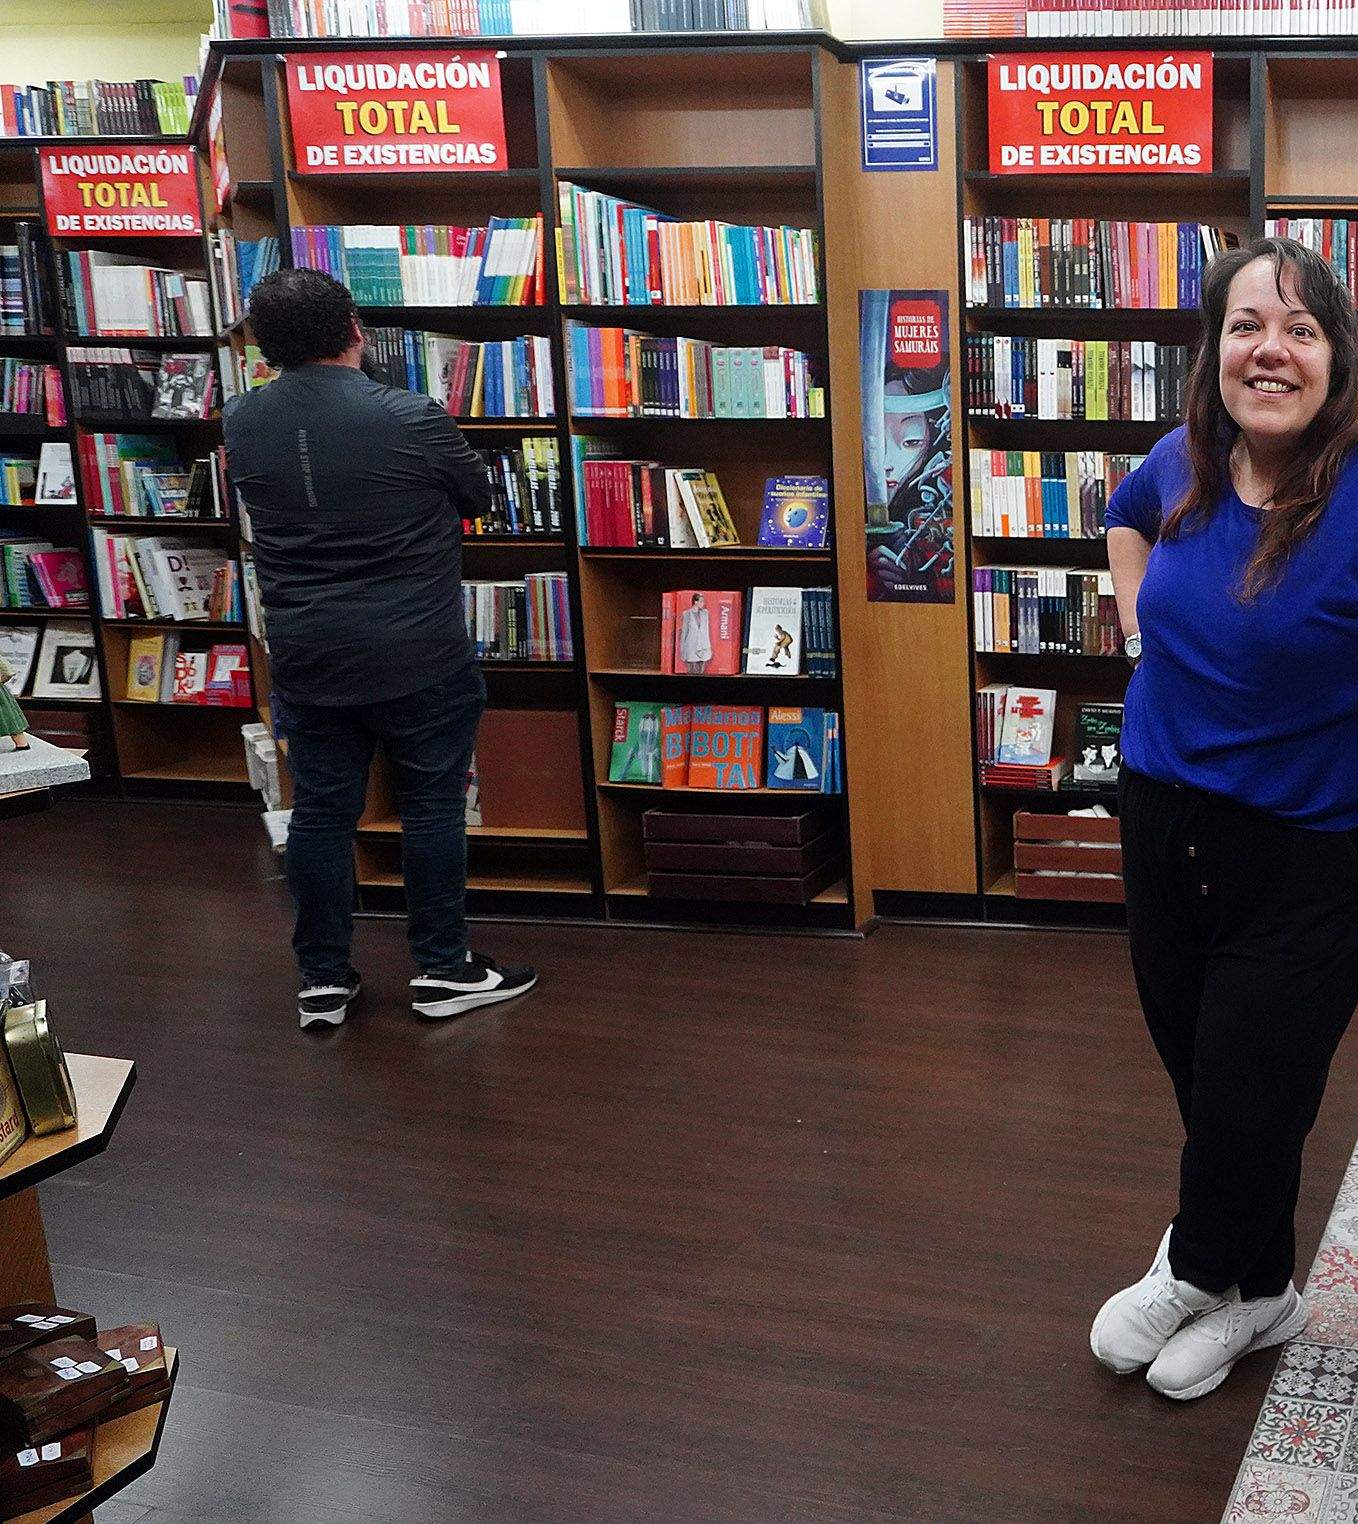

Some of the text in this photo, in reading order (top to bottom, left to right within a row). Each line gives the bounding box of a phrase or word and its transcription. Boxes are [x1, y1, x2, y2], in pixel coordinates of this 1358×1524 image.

[297, 55, 490, 94] LIQUIDACIÓN
[1000, 55, 1201, 95] LIQUIDACIÓN
[336, 100, 461, 135] TOTAL
[1036, 101, 1165, 135] TOTAL
[49, 150, 188, 177] LIQUIDACIÓN
[306, 143, 497, 165] DE EXISTENCIAS
[1001, 144, 1201, 166] DE EXISTENCIAS
[78, 182, 168, 208] TOTAL
[56, 214, 194, 231] DE EXISTENCIAS
[894, 325, 939, 338] MUJERES
[896, 315, 935, 324] HISTORIAS DE
[894, 339, 939, 353] SAMURÁIS
[720, 604, 731, 641] Armani
[615, 708, 626, 742] Starck
[770, 709, 801, 721] Alessi
